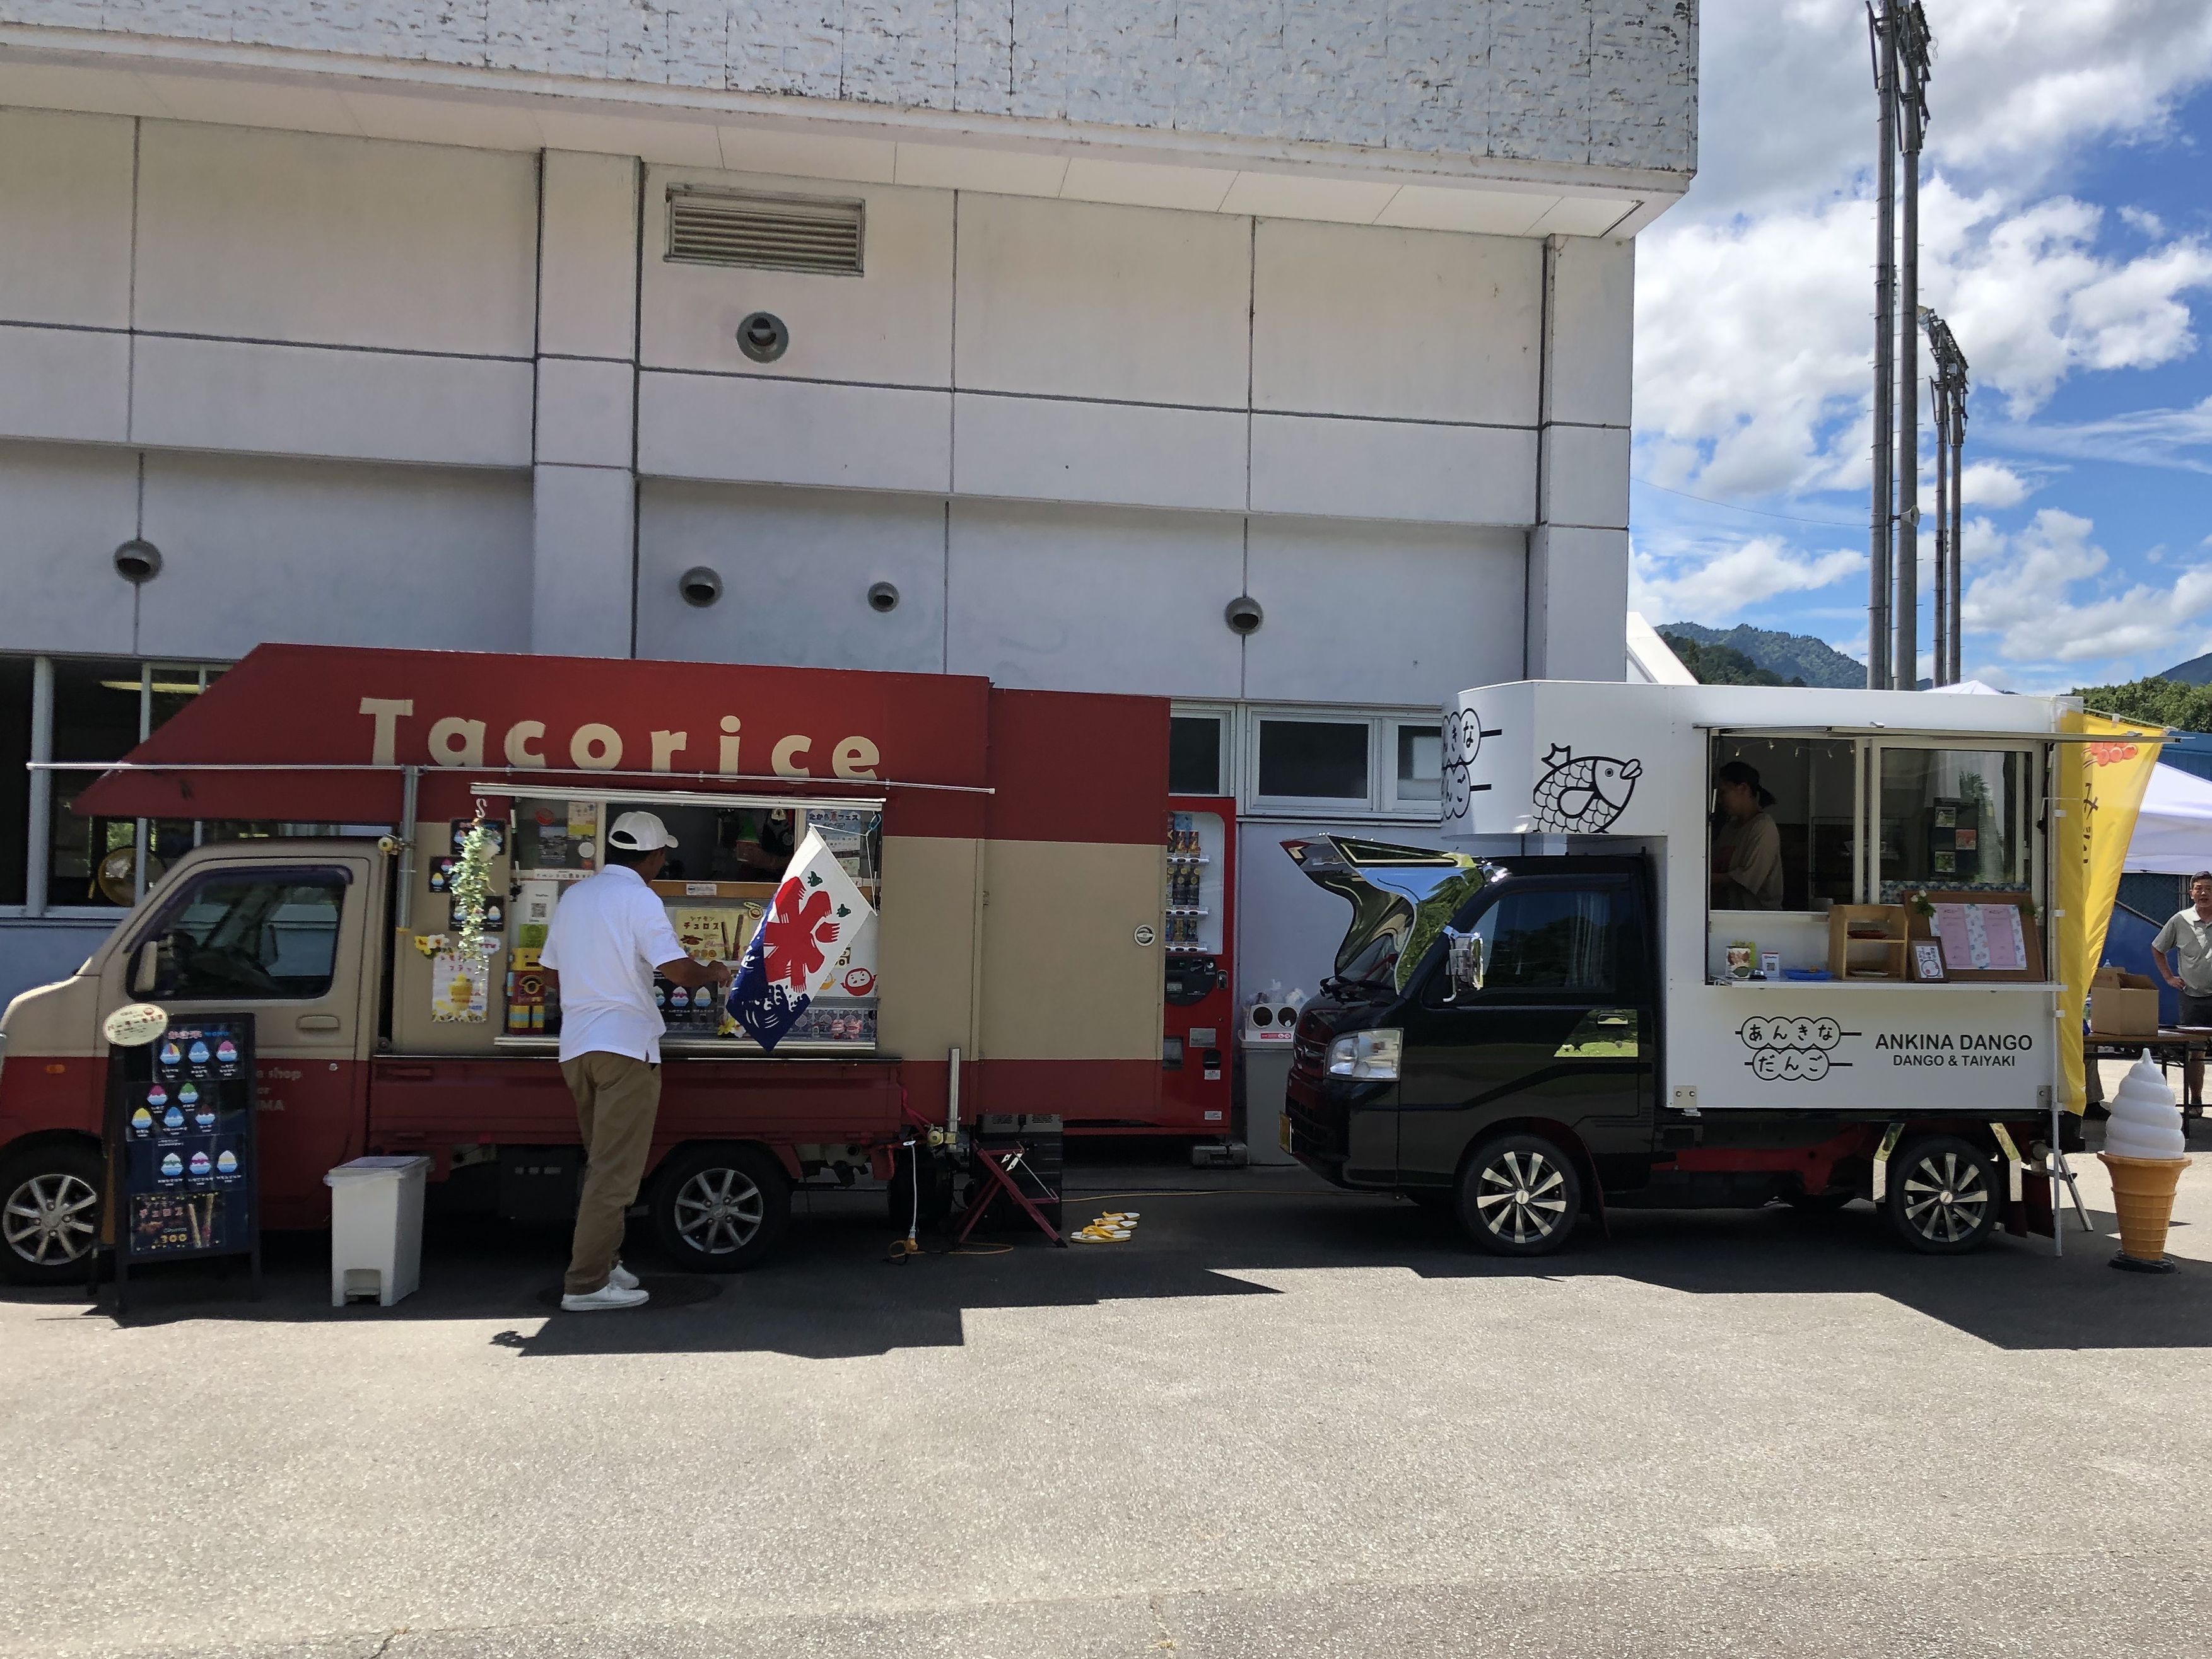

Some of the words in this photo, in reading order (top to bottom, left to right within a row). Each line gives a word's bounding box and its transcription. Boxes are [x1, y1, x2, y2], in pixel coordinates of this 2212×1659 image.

[360, 697, 881, 784] Tacorice
[683, 922, 720, 930] チュロス
[1749, 1023, 1833, 1042] あんきな
[1875, 1033, 1954, 1051] ANKINA
[1960, 1034, 2033, 1051] DANGO
[1758, 1054, 1823, 1073] だんご
[1893, 1054, 1945, 1067] DANGO
[1948, 1055, 1958, 1067] &
[1961, 1055, 2016, 1067] TAIYAKI
